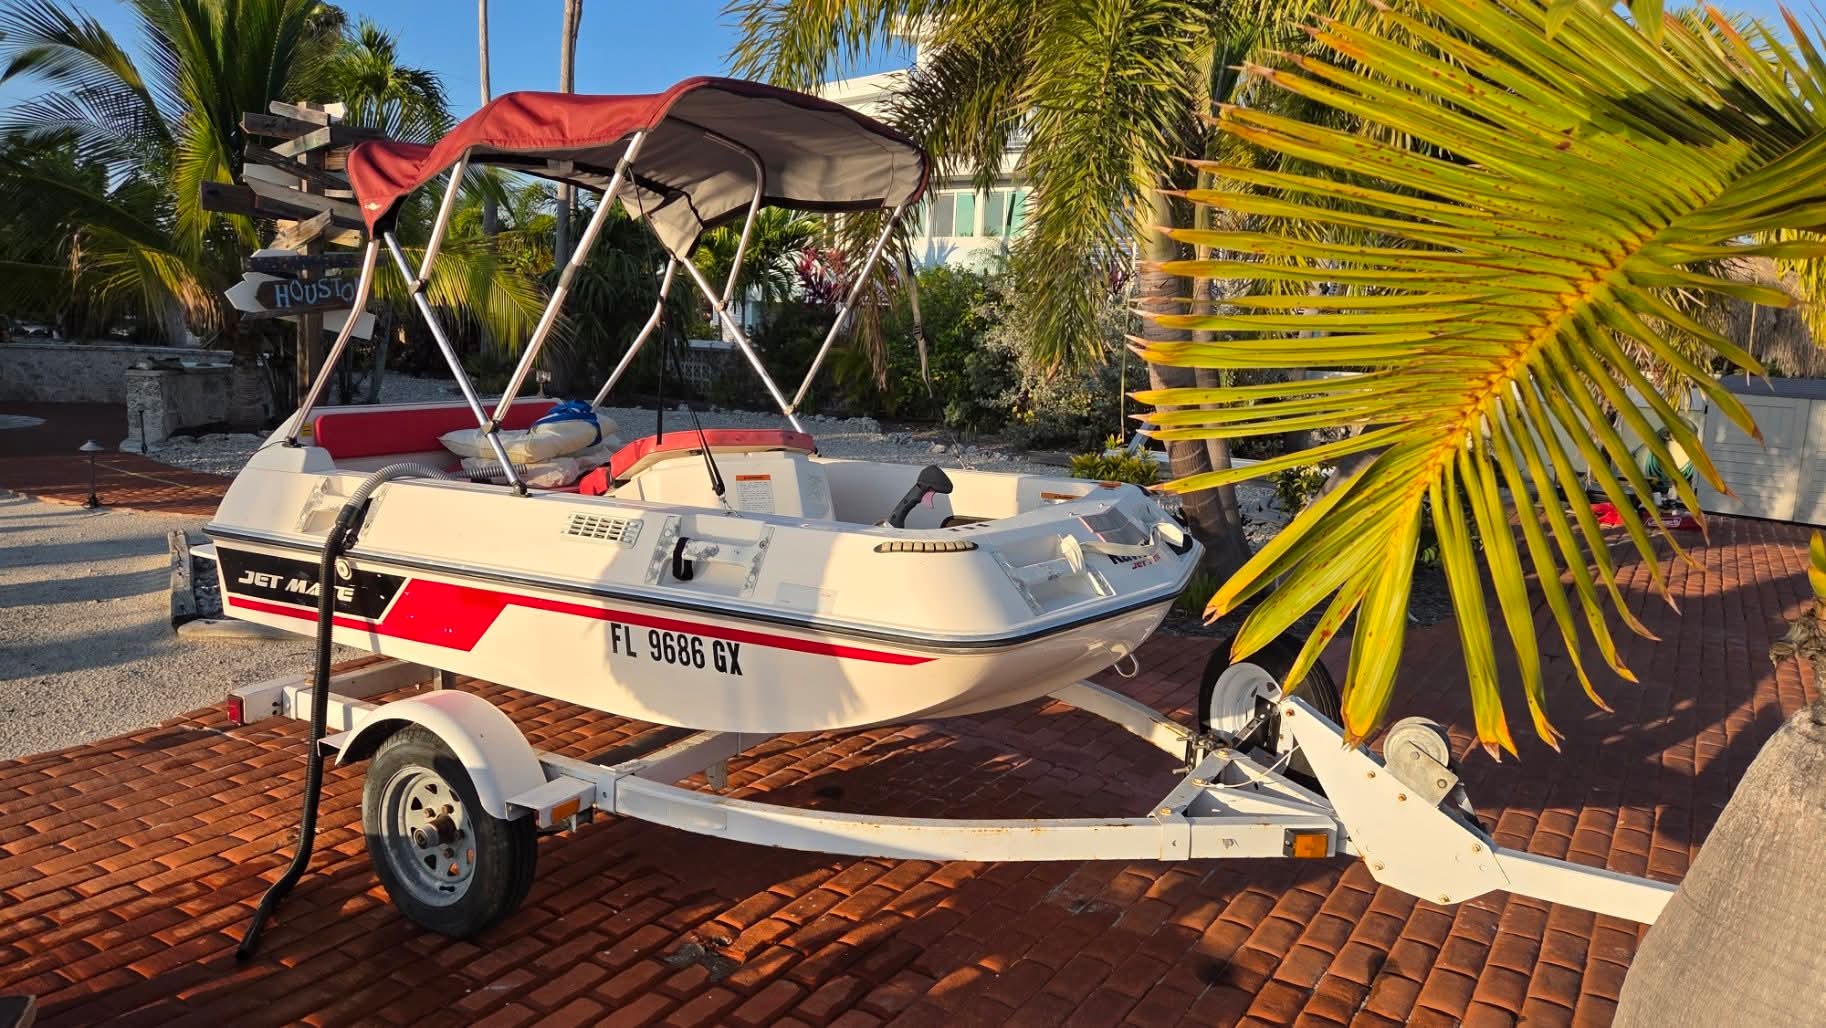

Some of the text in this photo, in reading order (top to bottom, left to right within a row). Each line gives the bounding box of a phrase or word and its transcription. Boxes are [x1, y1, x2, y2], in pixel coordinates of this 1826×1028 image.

[275, 278, 360, 307] HOUSTO
[238, 570, 355, 602] JET MAE
[610, 622, 743, 676] FL 9686 GX
